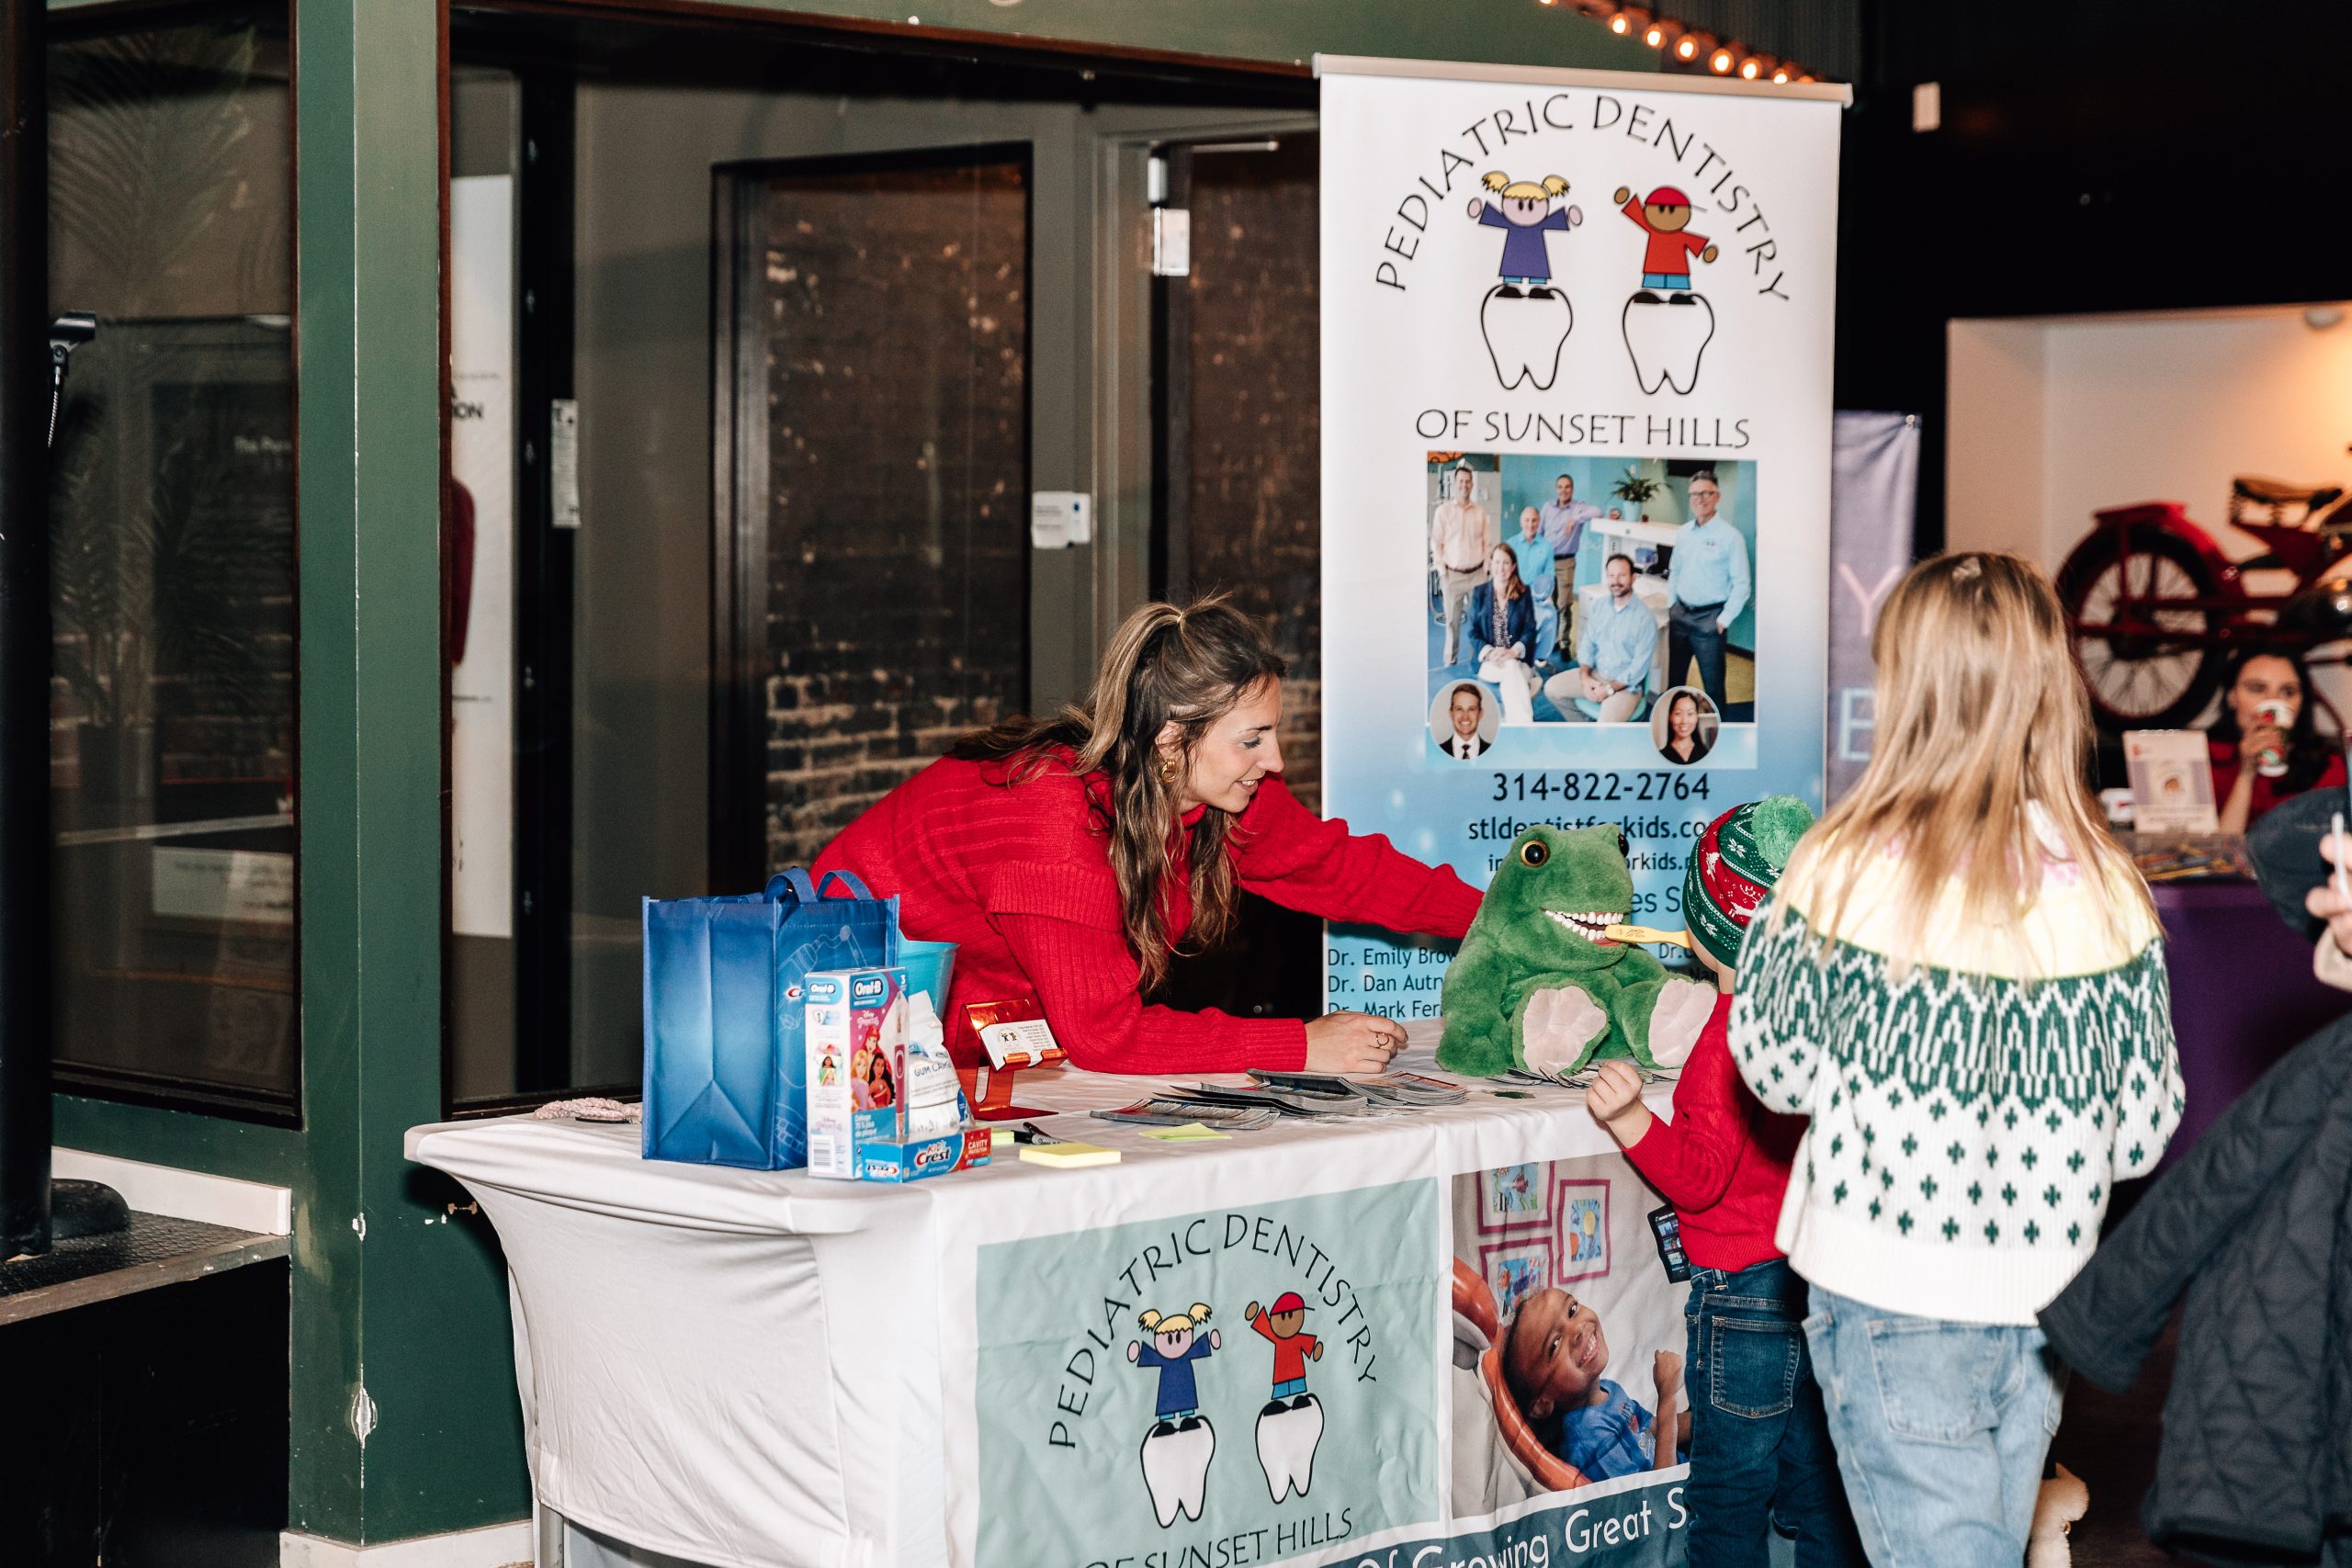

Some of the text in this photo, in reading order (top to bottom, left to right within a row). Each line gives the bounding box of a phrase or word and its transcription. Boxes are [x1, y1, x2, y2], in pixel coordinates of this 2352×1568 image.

[1375, 94, 1790, 301] PEDIATRIC DENTISTRY
[1416, 409, 1750, 449] OF SUNSET HILLS
[1493, 773, 1711, 802] 314-822-2764
[1666, 886, 1681, 912] S
[1329, 949, 1355, 965] Dr.
[1364, 948, 1412, 969] Emily
[1658, 942, 1682, 959] Dr.
[854, 979, 883, 998] Oral-B
[1329, 976, 1355, 992] Dr.
[1364, 975, 1397, 992] Dan
[1364, 1000, 1407, 1019] Mark
[1412, 999, 1443, 1018] Fer
[913, 1066, 932, 1077] GUM
[967, 1138, 989, 1150] CAVITY
[916, 1148, 950, 1166] Crest
[1048, 1213, 1377, 1449] PEDIATRIC DENTISTRY
[1565, 1499, 1652, 1553] Great
[1667, 1486, 1688, 1529] S
[1276, 1507, 1352, 1555] HILLS
